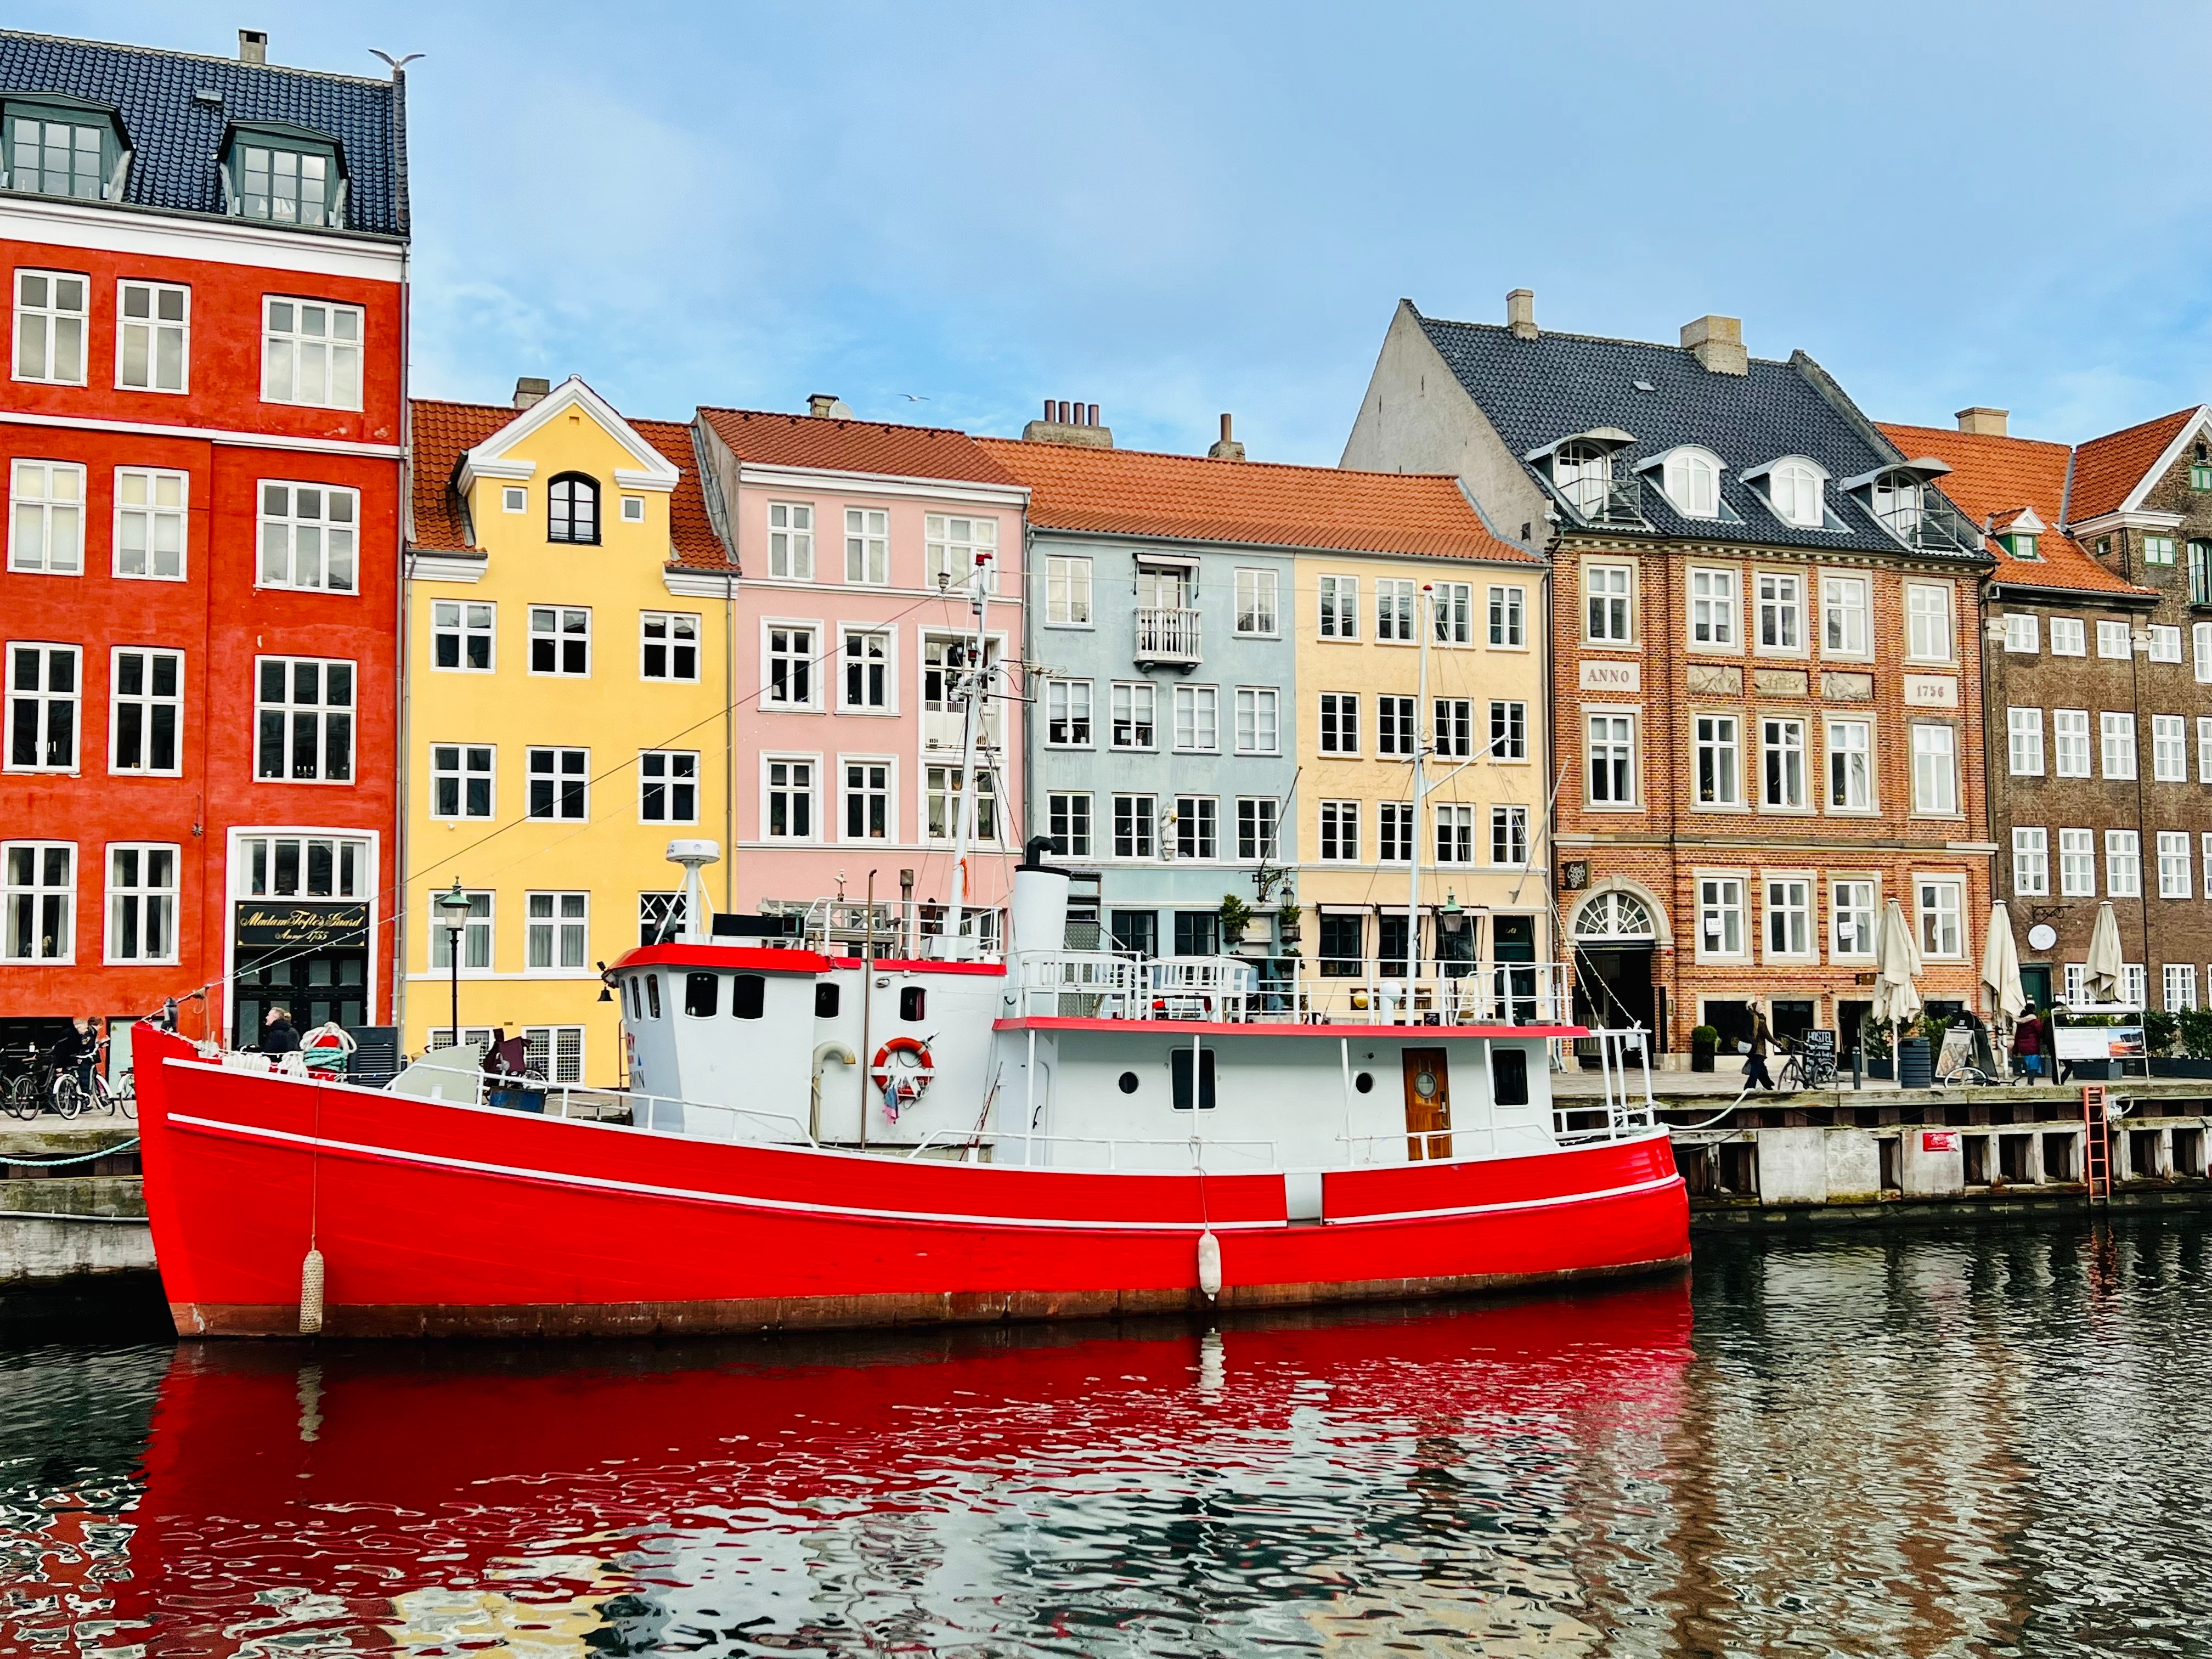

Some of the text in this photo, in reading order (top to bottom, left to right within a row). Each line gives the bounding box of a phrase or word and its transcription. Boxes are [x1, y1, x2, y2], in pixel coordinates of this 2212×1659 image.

[1587, 669, 1629, 682] ANNO
[1917, 685, 1944, 697] 1756
[240, 912, 289, 927] Madam
[326, 912, 364, 927] Gaard
[306, 930, 330, 943] 1755
[1806, 1031, 1833, 1043] HOSTEL
